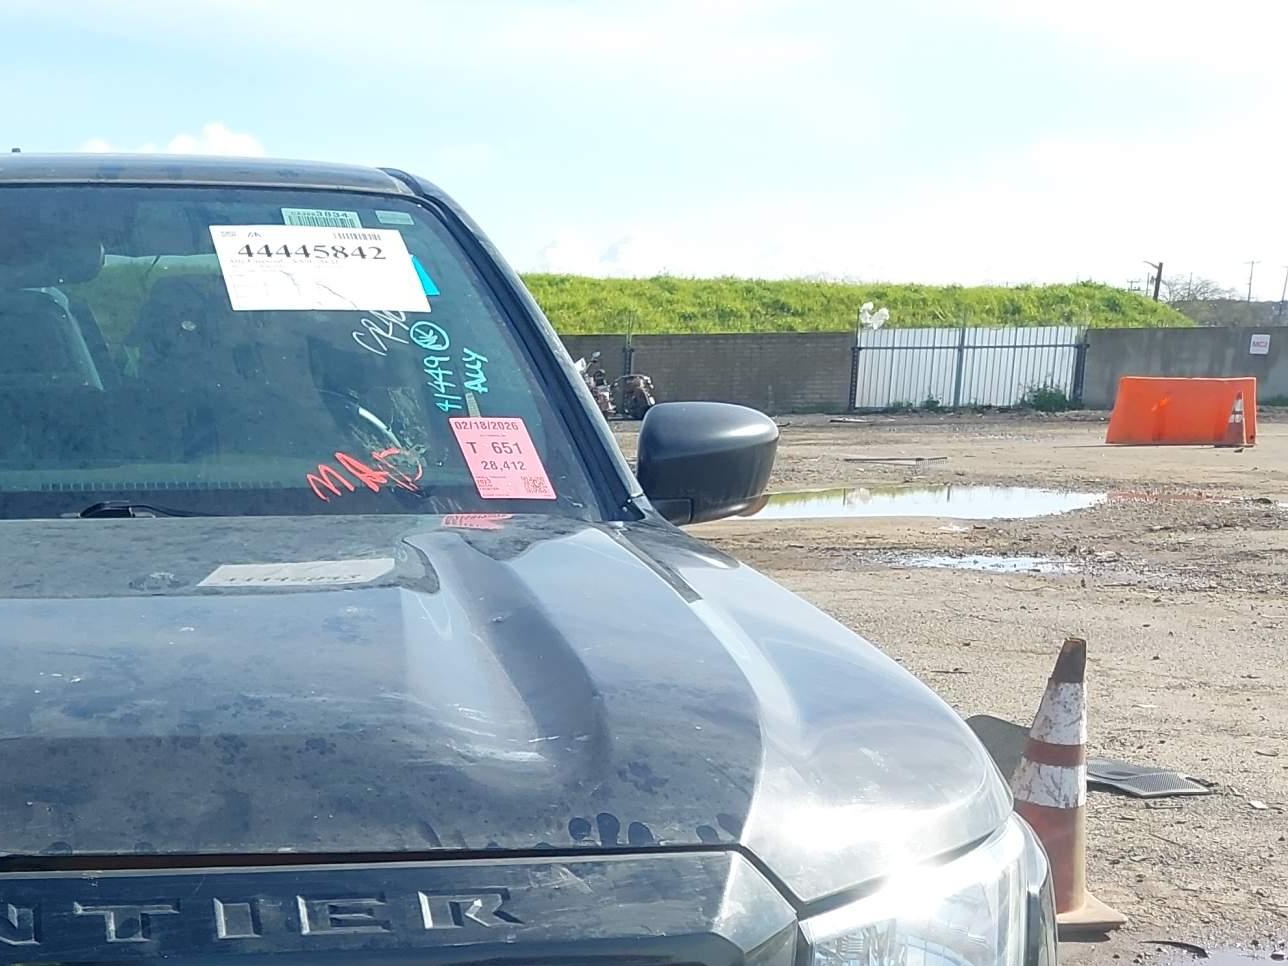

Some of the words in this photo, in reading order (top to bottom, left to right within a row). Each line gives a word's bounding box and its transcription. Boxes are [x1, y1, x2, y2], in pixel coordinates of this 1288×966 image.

[238, 244, 386, 260] 44445842
[462, 347, 488, 394] ALLY
[454, 421, 519, 430] 02/18/2026
[466, 441, 477, 454] T
[491, 441, 523, 454] 651
[481, 460, 527, 471] 28,412
